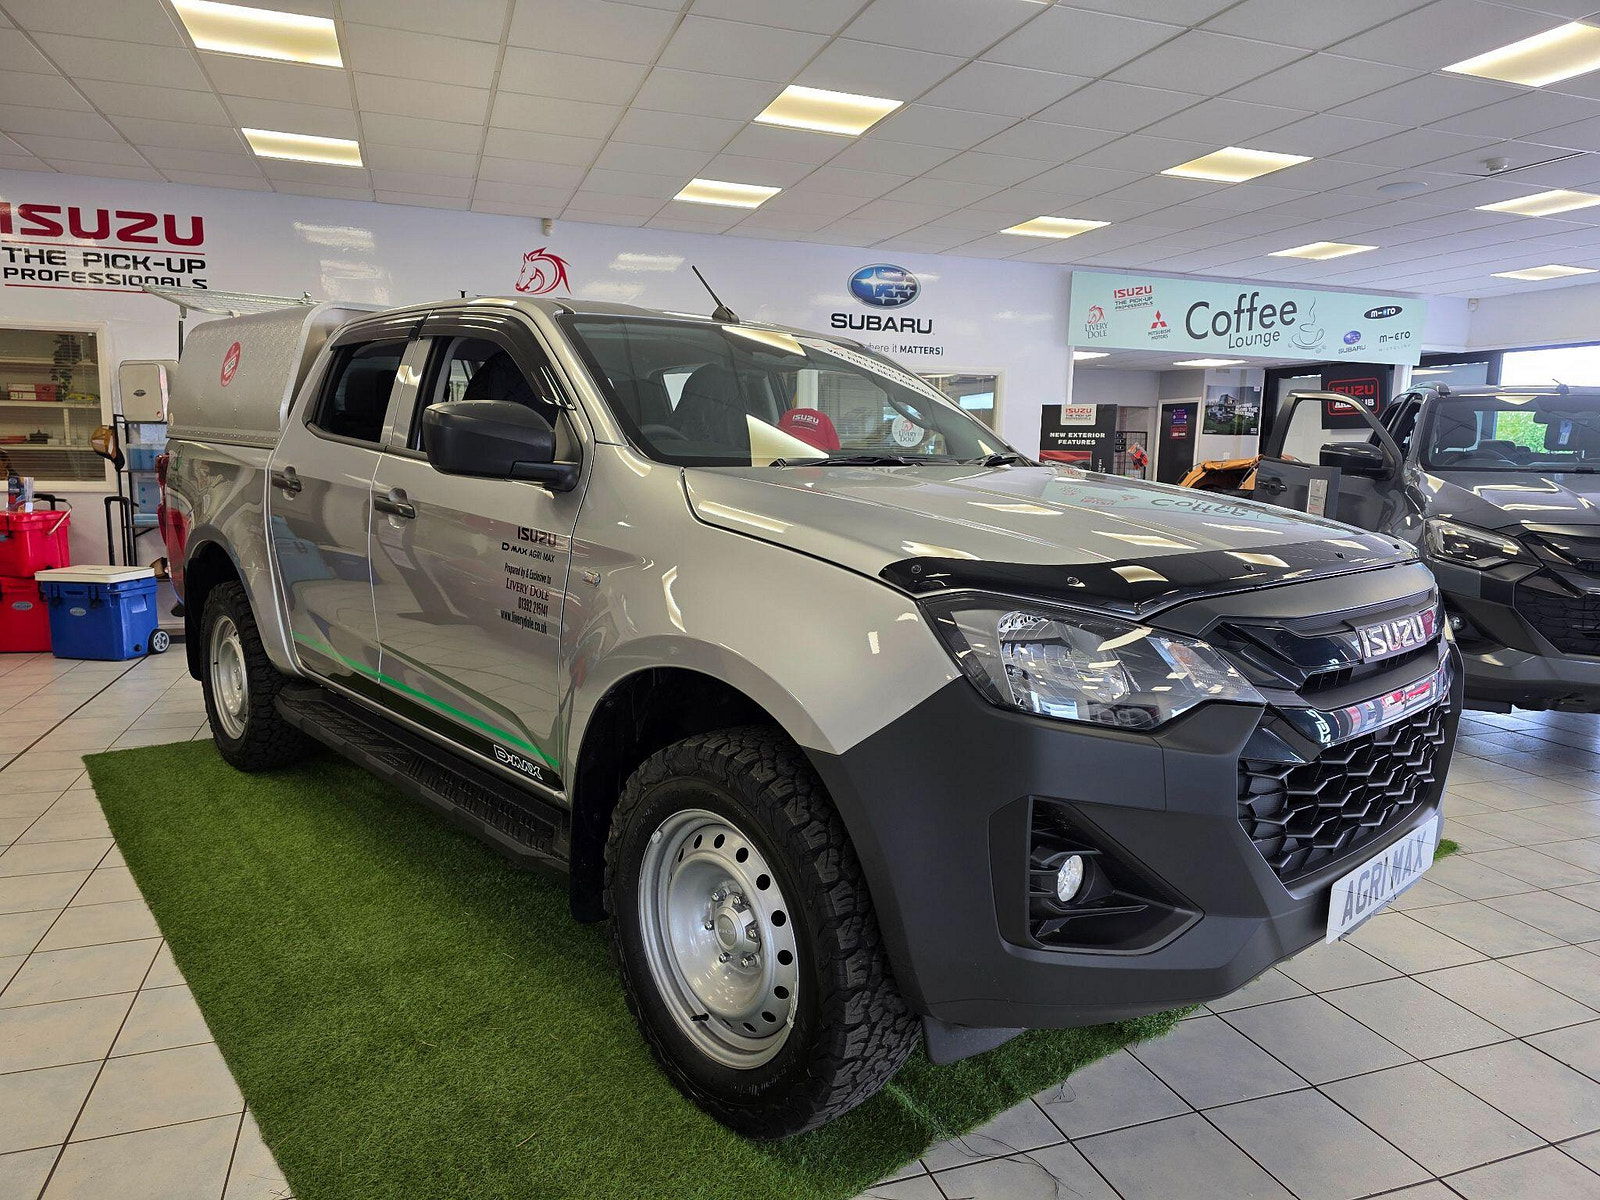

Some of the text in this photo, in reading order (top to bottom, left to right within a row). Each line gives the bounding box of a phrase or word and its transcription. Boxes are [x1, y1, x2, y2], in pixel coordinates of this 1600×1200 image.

[0, 202, 205, 246] ISUZU
[2, 246, 206, 274] THE PICK-UP
[3, 267, 207, 289] PROFESSIONALS
[1114, 286, 1152, 298] ISUZU
[830, 312, 933, 335] SUBARU
[1185, 291, 1298, 340] Coffee
[1085, 322, 1108, 332] LIVERY
[1087, 330, 1107, 339] DOLE
[864, 342, 945, 356] here it MATTERS)
[1228, 331, 1281, 349] Lounge
[1338, 344, 1367, 354] SUBARU
[792, 413, 820, 424] ISUZU
[517, 526, 557, 547] ISUZU
[529, 549, 542, 560] AGRI
[543, 553, 556, 563] MAX
[505, 577, 549, 601] LIVERY DOLE
[1359, 614, 1425, 658] ISUZU
[1341, 829, 1427, 927] AGRI MAX
